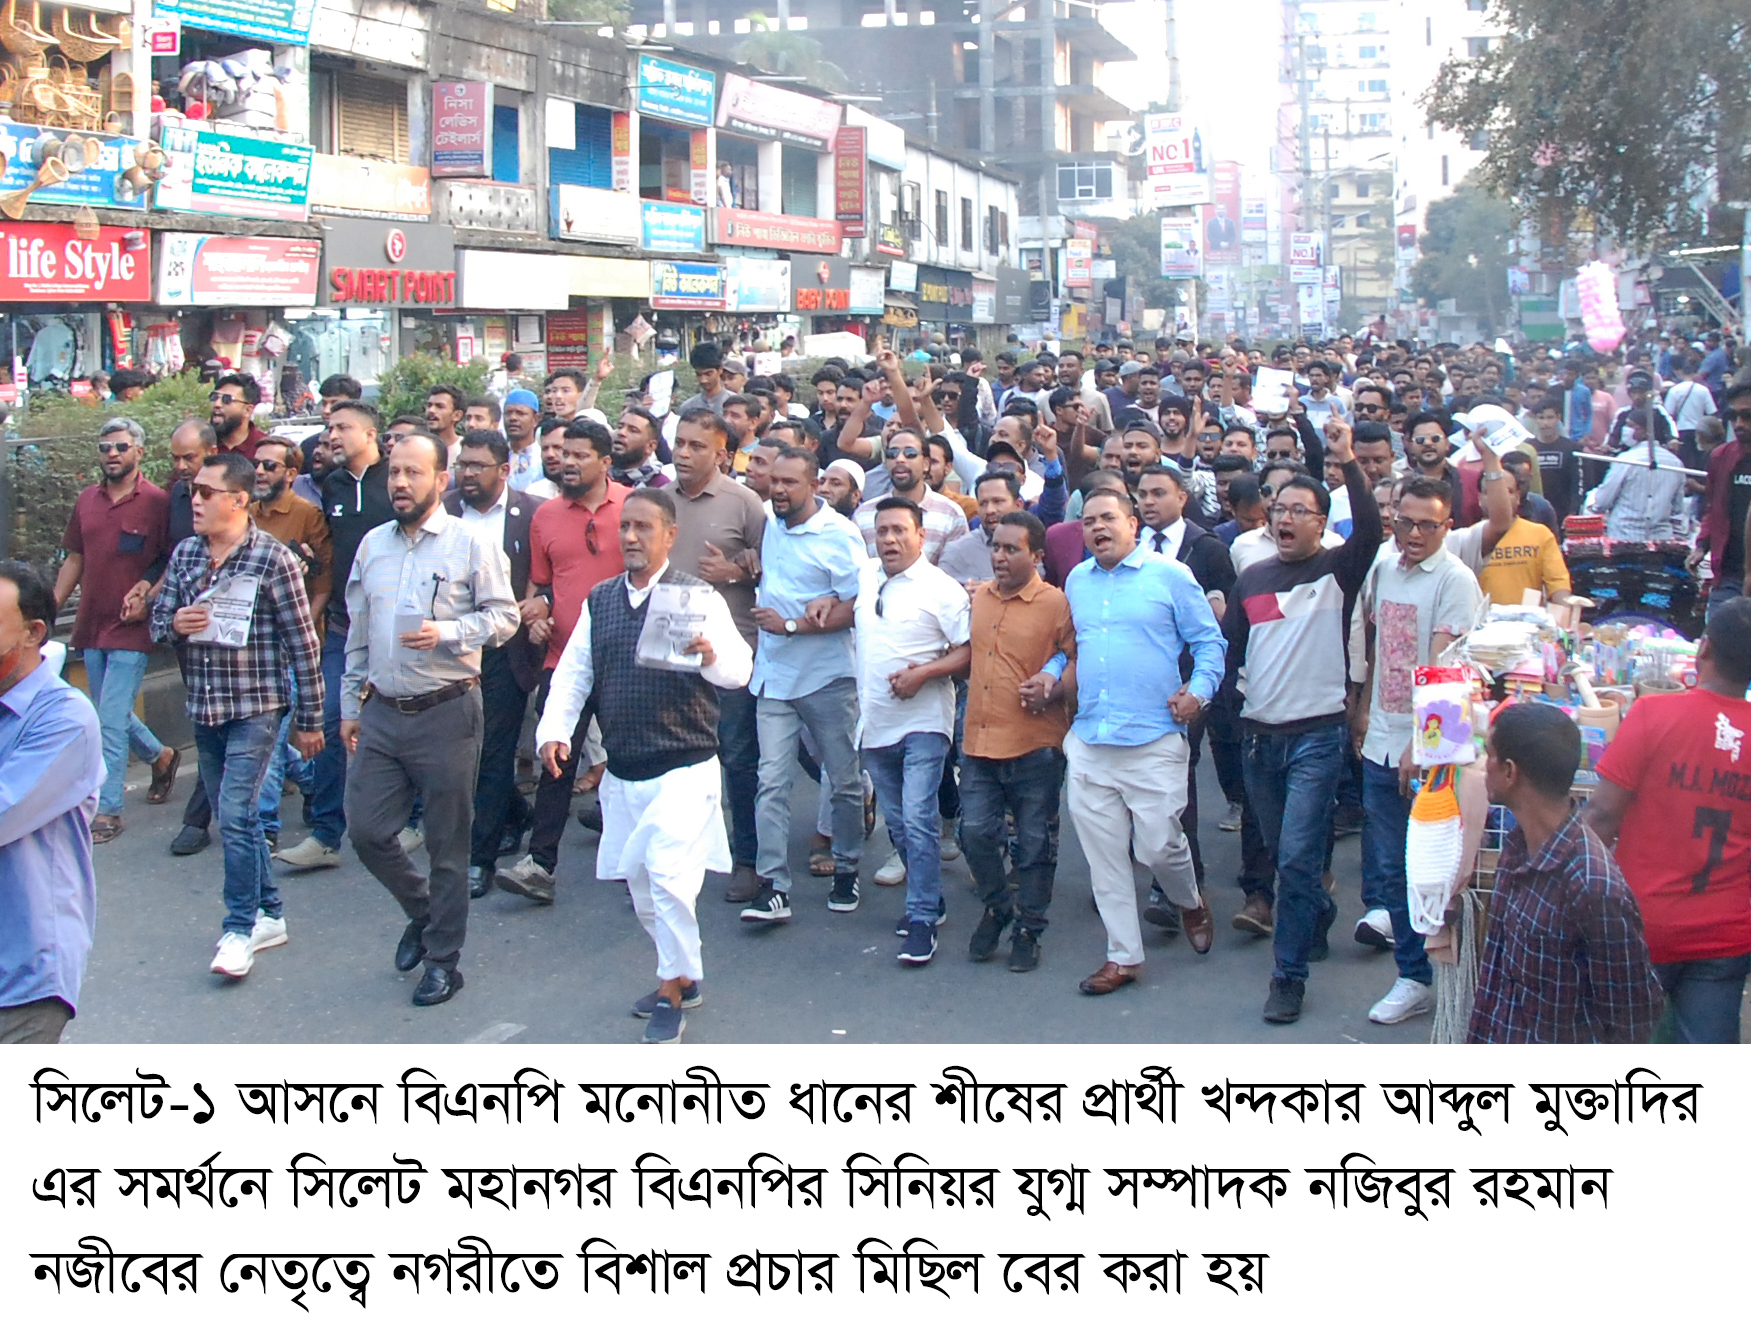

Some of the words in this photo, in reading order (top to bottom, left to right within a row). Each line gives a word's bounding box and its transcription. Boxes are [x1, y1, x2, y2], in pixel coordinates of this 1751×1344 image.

[444, 96, 474, 111] নিসা
[439, 113, 478, 128] লেডিস
[435, 129, 483, 145] টেইলার্স
[8, 236, 57, 279] life
[64, 239, 136, 290] Style
[331, 267, 400, 302] SMART
[403, 270, 456, 303] POINT
[796, 287, 822, 310] BABY
[824, 288, 850, 310] POINT
[1491, 545, 1540, 560] BERRY
[1691, 806, 1733, 895] 7
